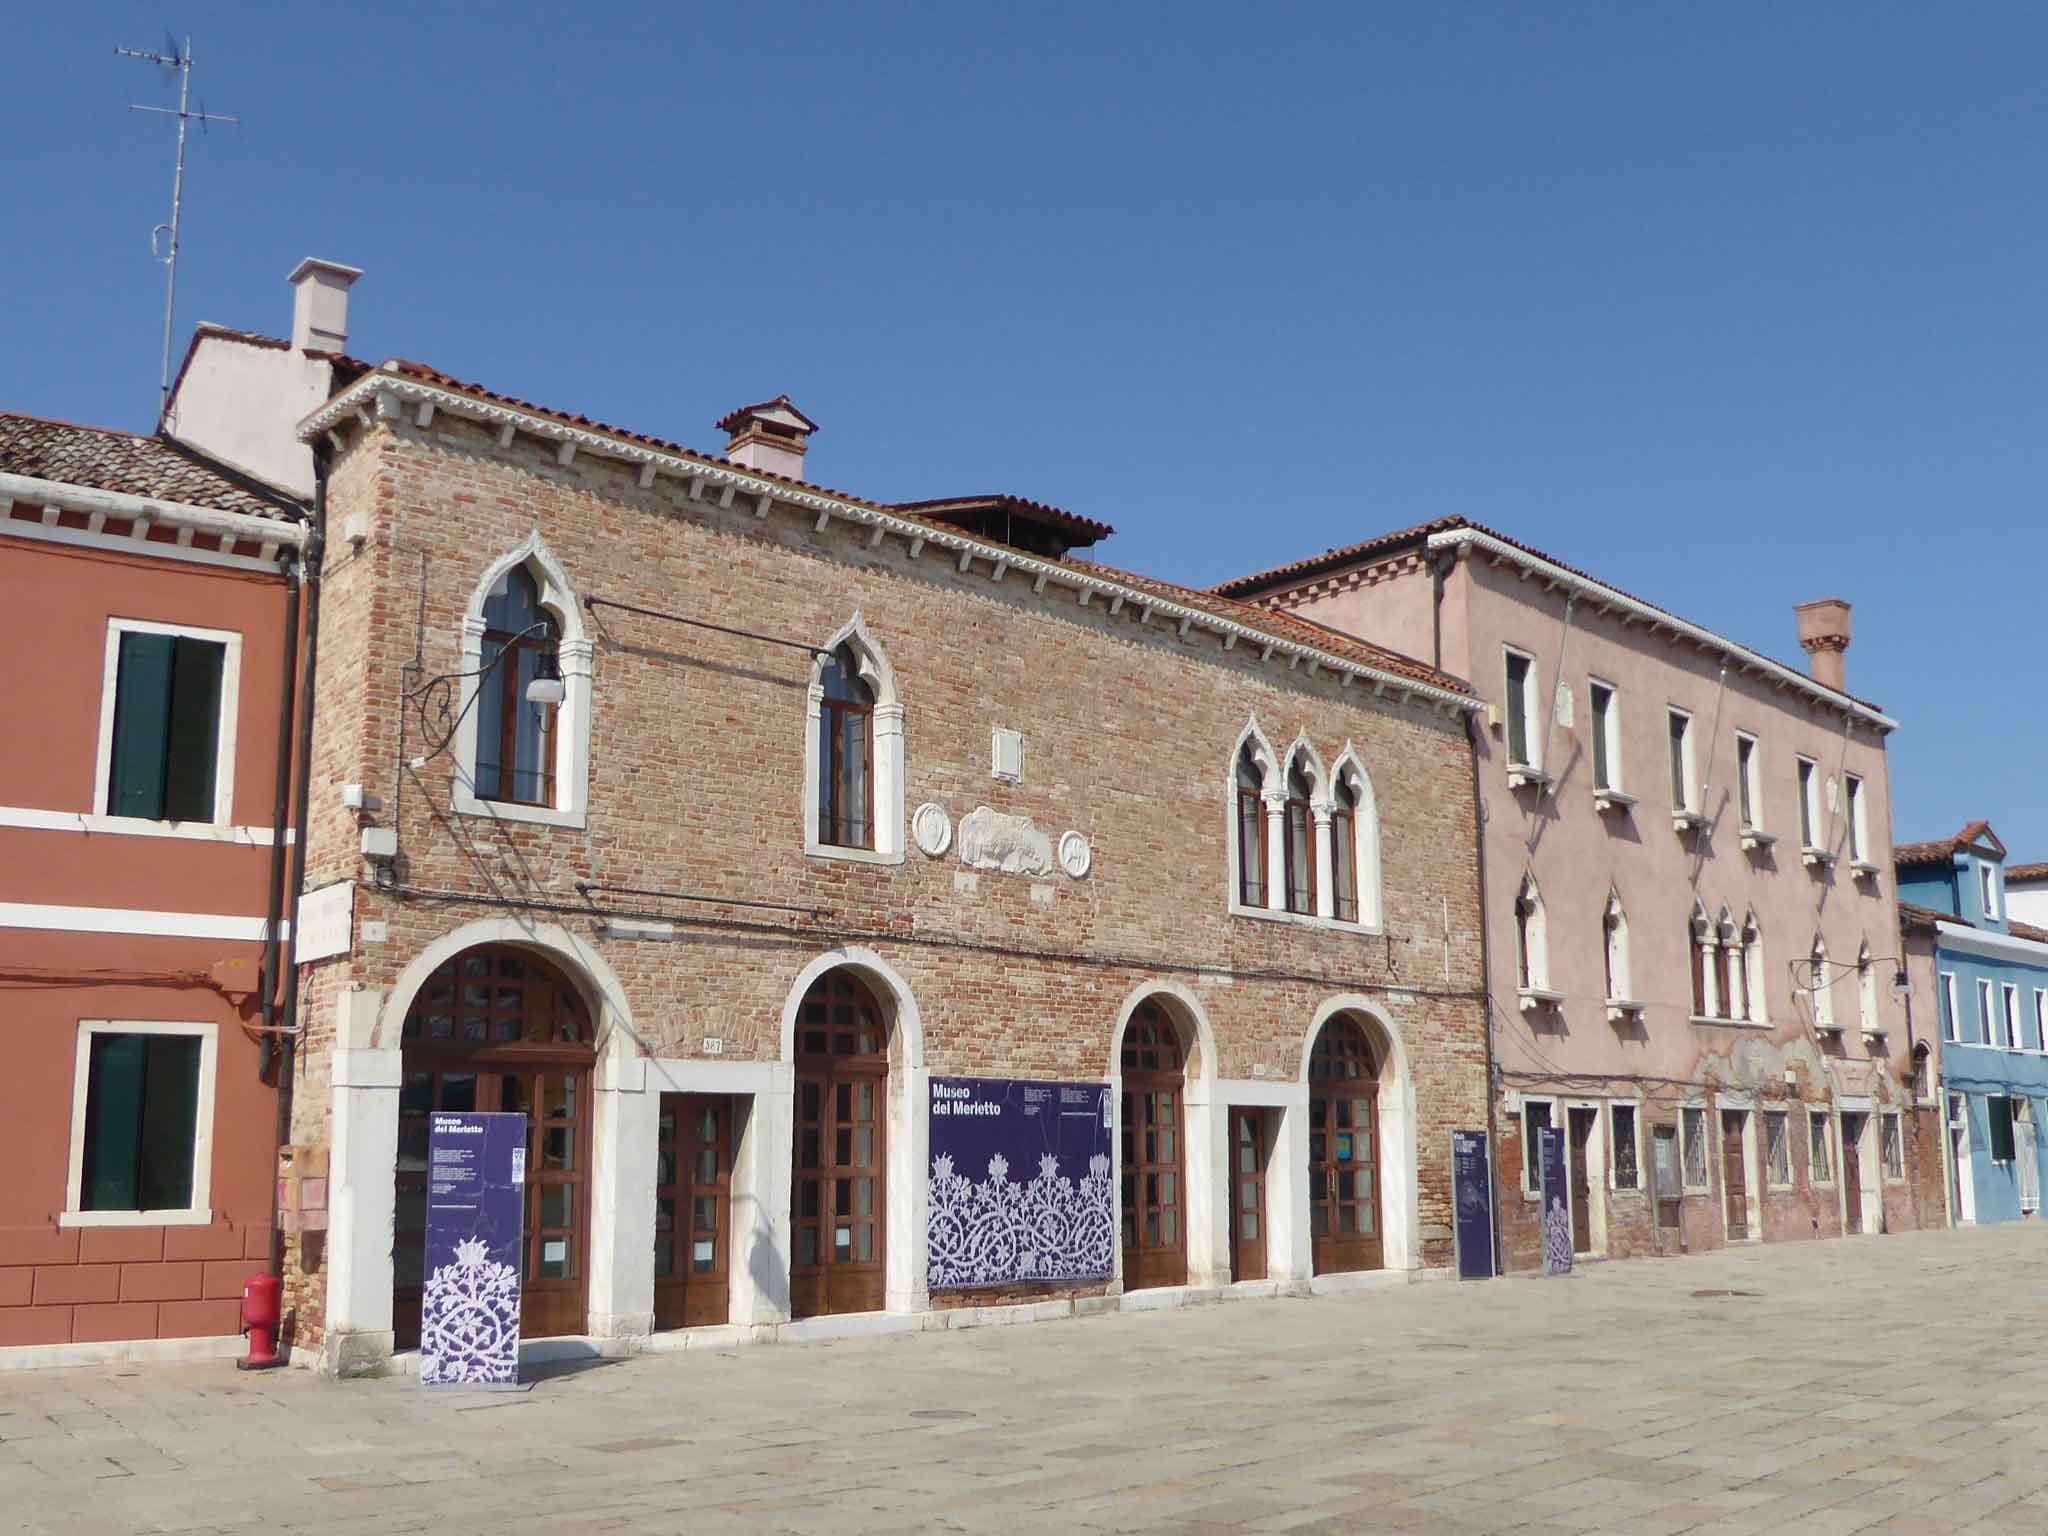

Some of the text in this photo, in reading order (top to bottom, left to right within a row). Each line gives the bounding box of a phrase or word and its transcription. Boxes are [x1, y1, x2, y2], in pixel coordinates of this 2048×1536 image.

[933, 1083, 970, 1098] Museo
[933, 1100, 1001, 1115] del Merletto
[435, 1117, 462, 1125] Museo
